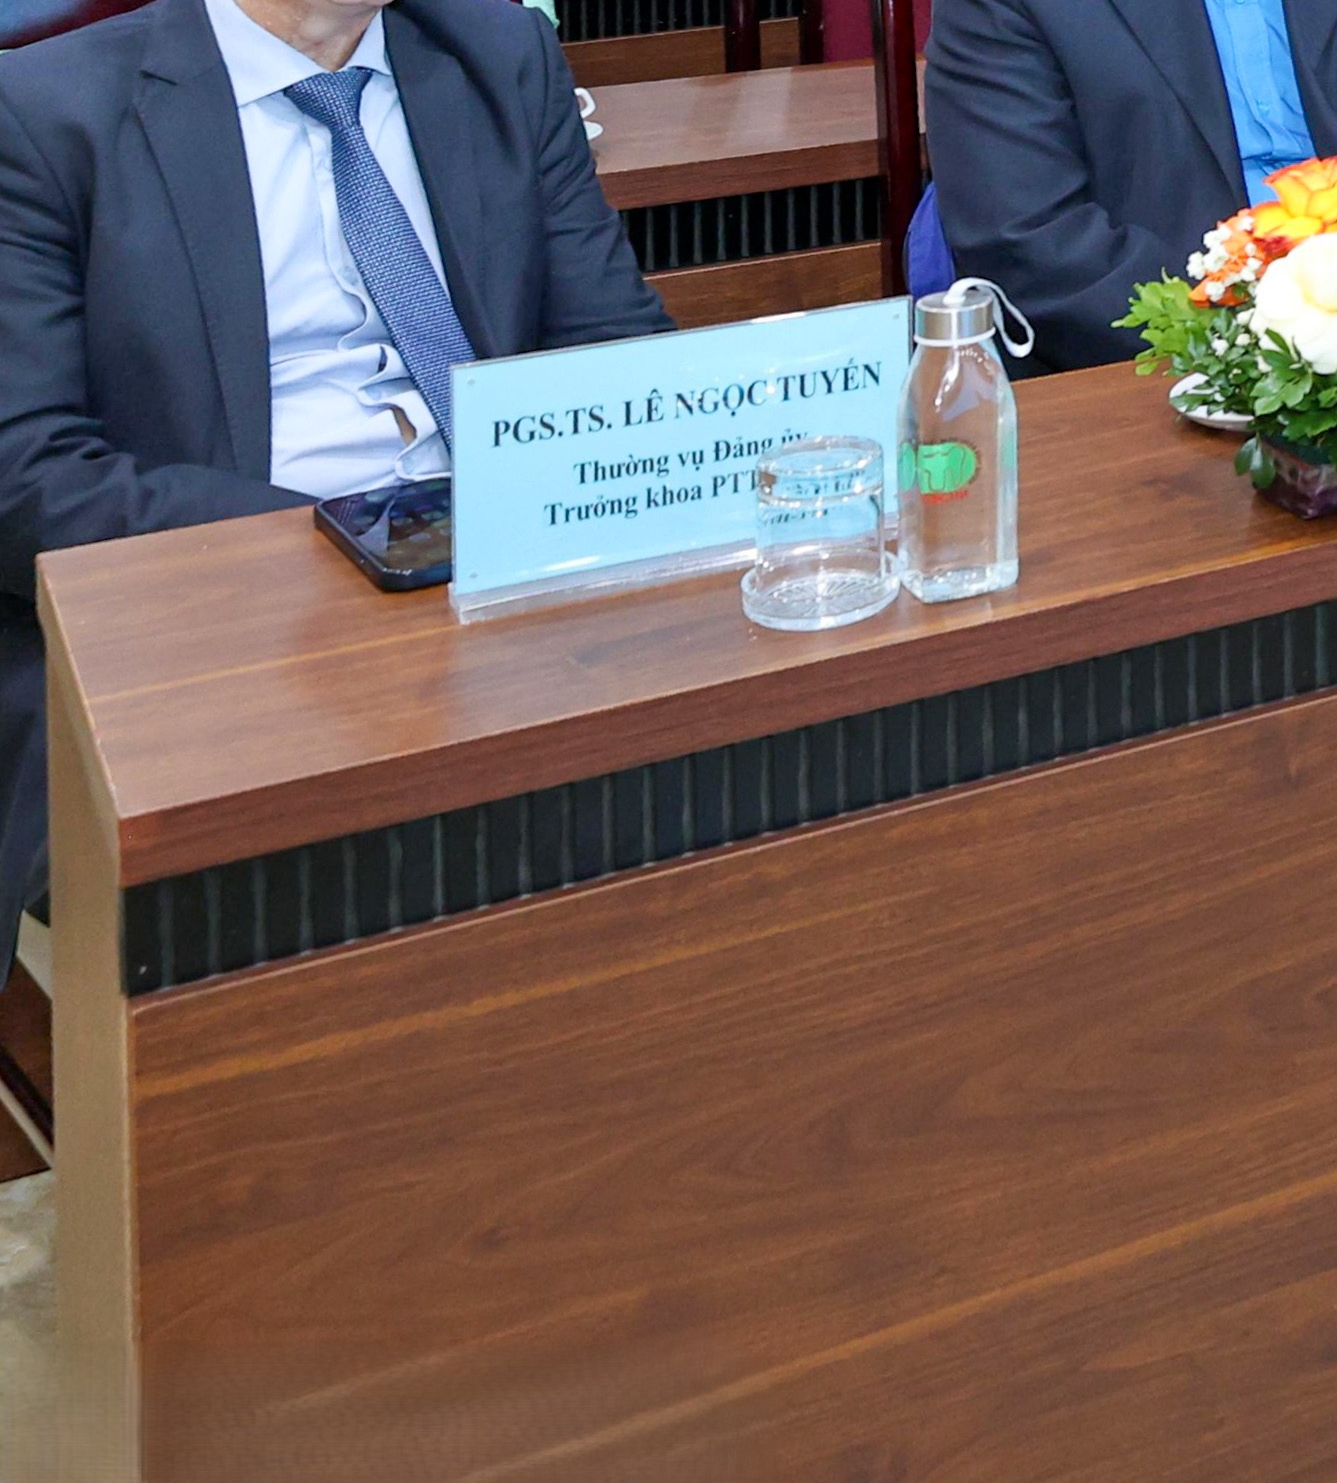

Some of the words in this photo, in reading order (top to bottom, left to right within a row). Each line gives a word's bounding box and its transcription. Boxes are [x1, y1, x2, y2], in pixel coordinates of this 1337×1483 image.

[492, 404, 613, 449] PGS.TS.
[623, 388, 665, 428] LÊ
[674, 379, 768, 419] NGỌC
[776, 357, 882, 403] TUYẾN
[573, 454, 670, 485] Thường
[676, 447, 704, 472] vụ
[713, 435, 774, 463] Đảng
[543, 493, 638, 527] Trưởng
[646, 483, 703, 510] khoa
